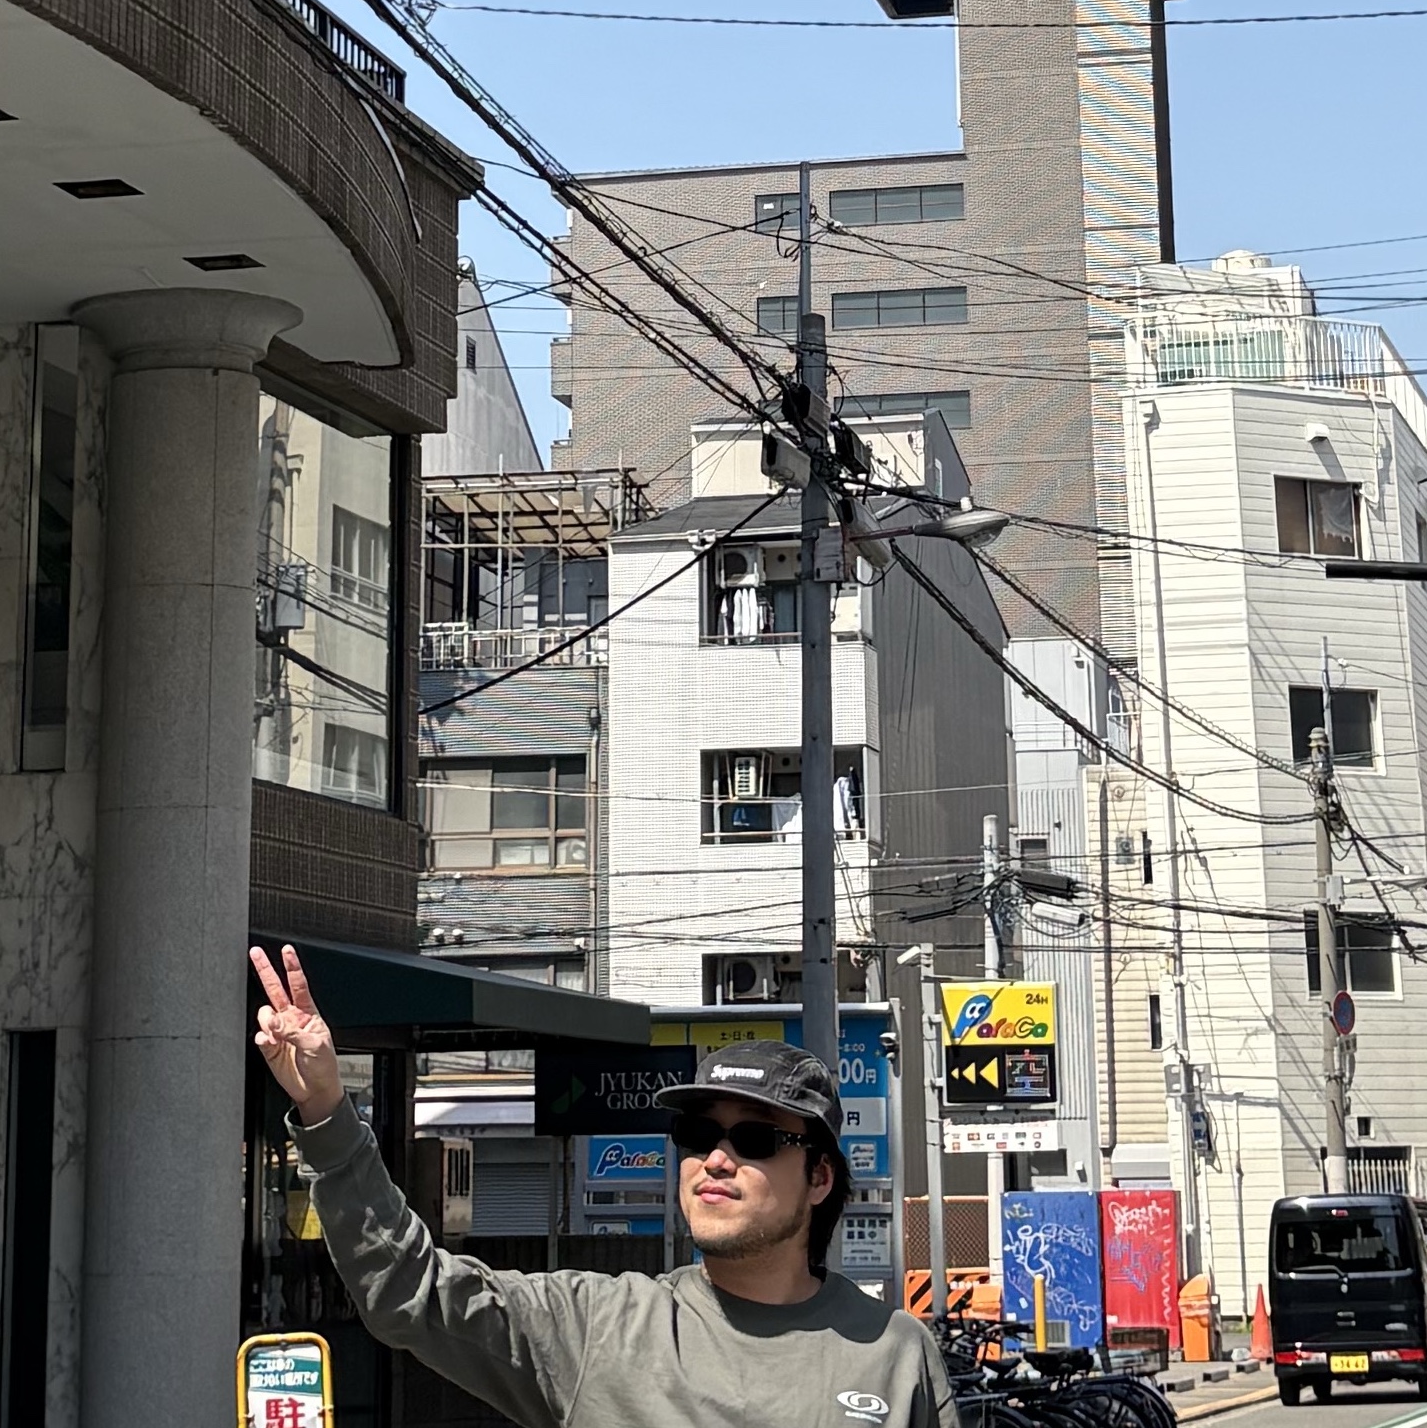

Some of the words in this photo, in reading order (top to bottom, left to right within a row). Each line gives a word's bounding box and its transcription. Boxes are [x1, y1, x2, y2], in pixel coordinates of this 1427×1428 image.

[1025, 992, 1049, 1005] 24H
[594, 1071, 683, 1097] JYUKAN
[606, 1091, 657, 1110] GRO
